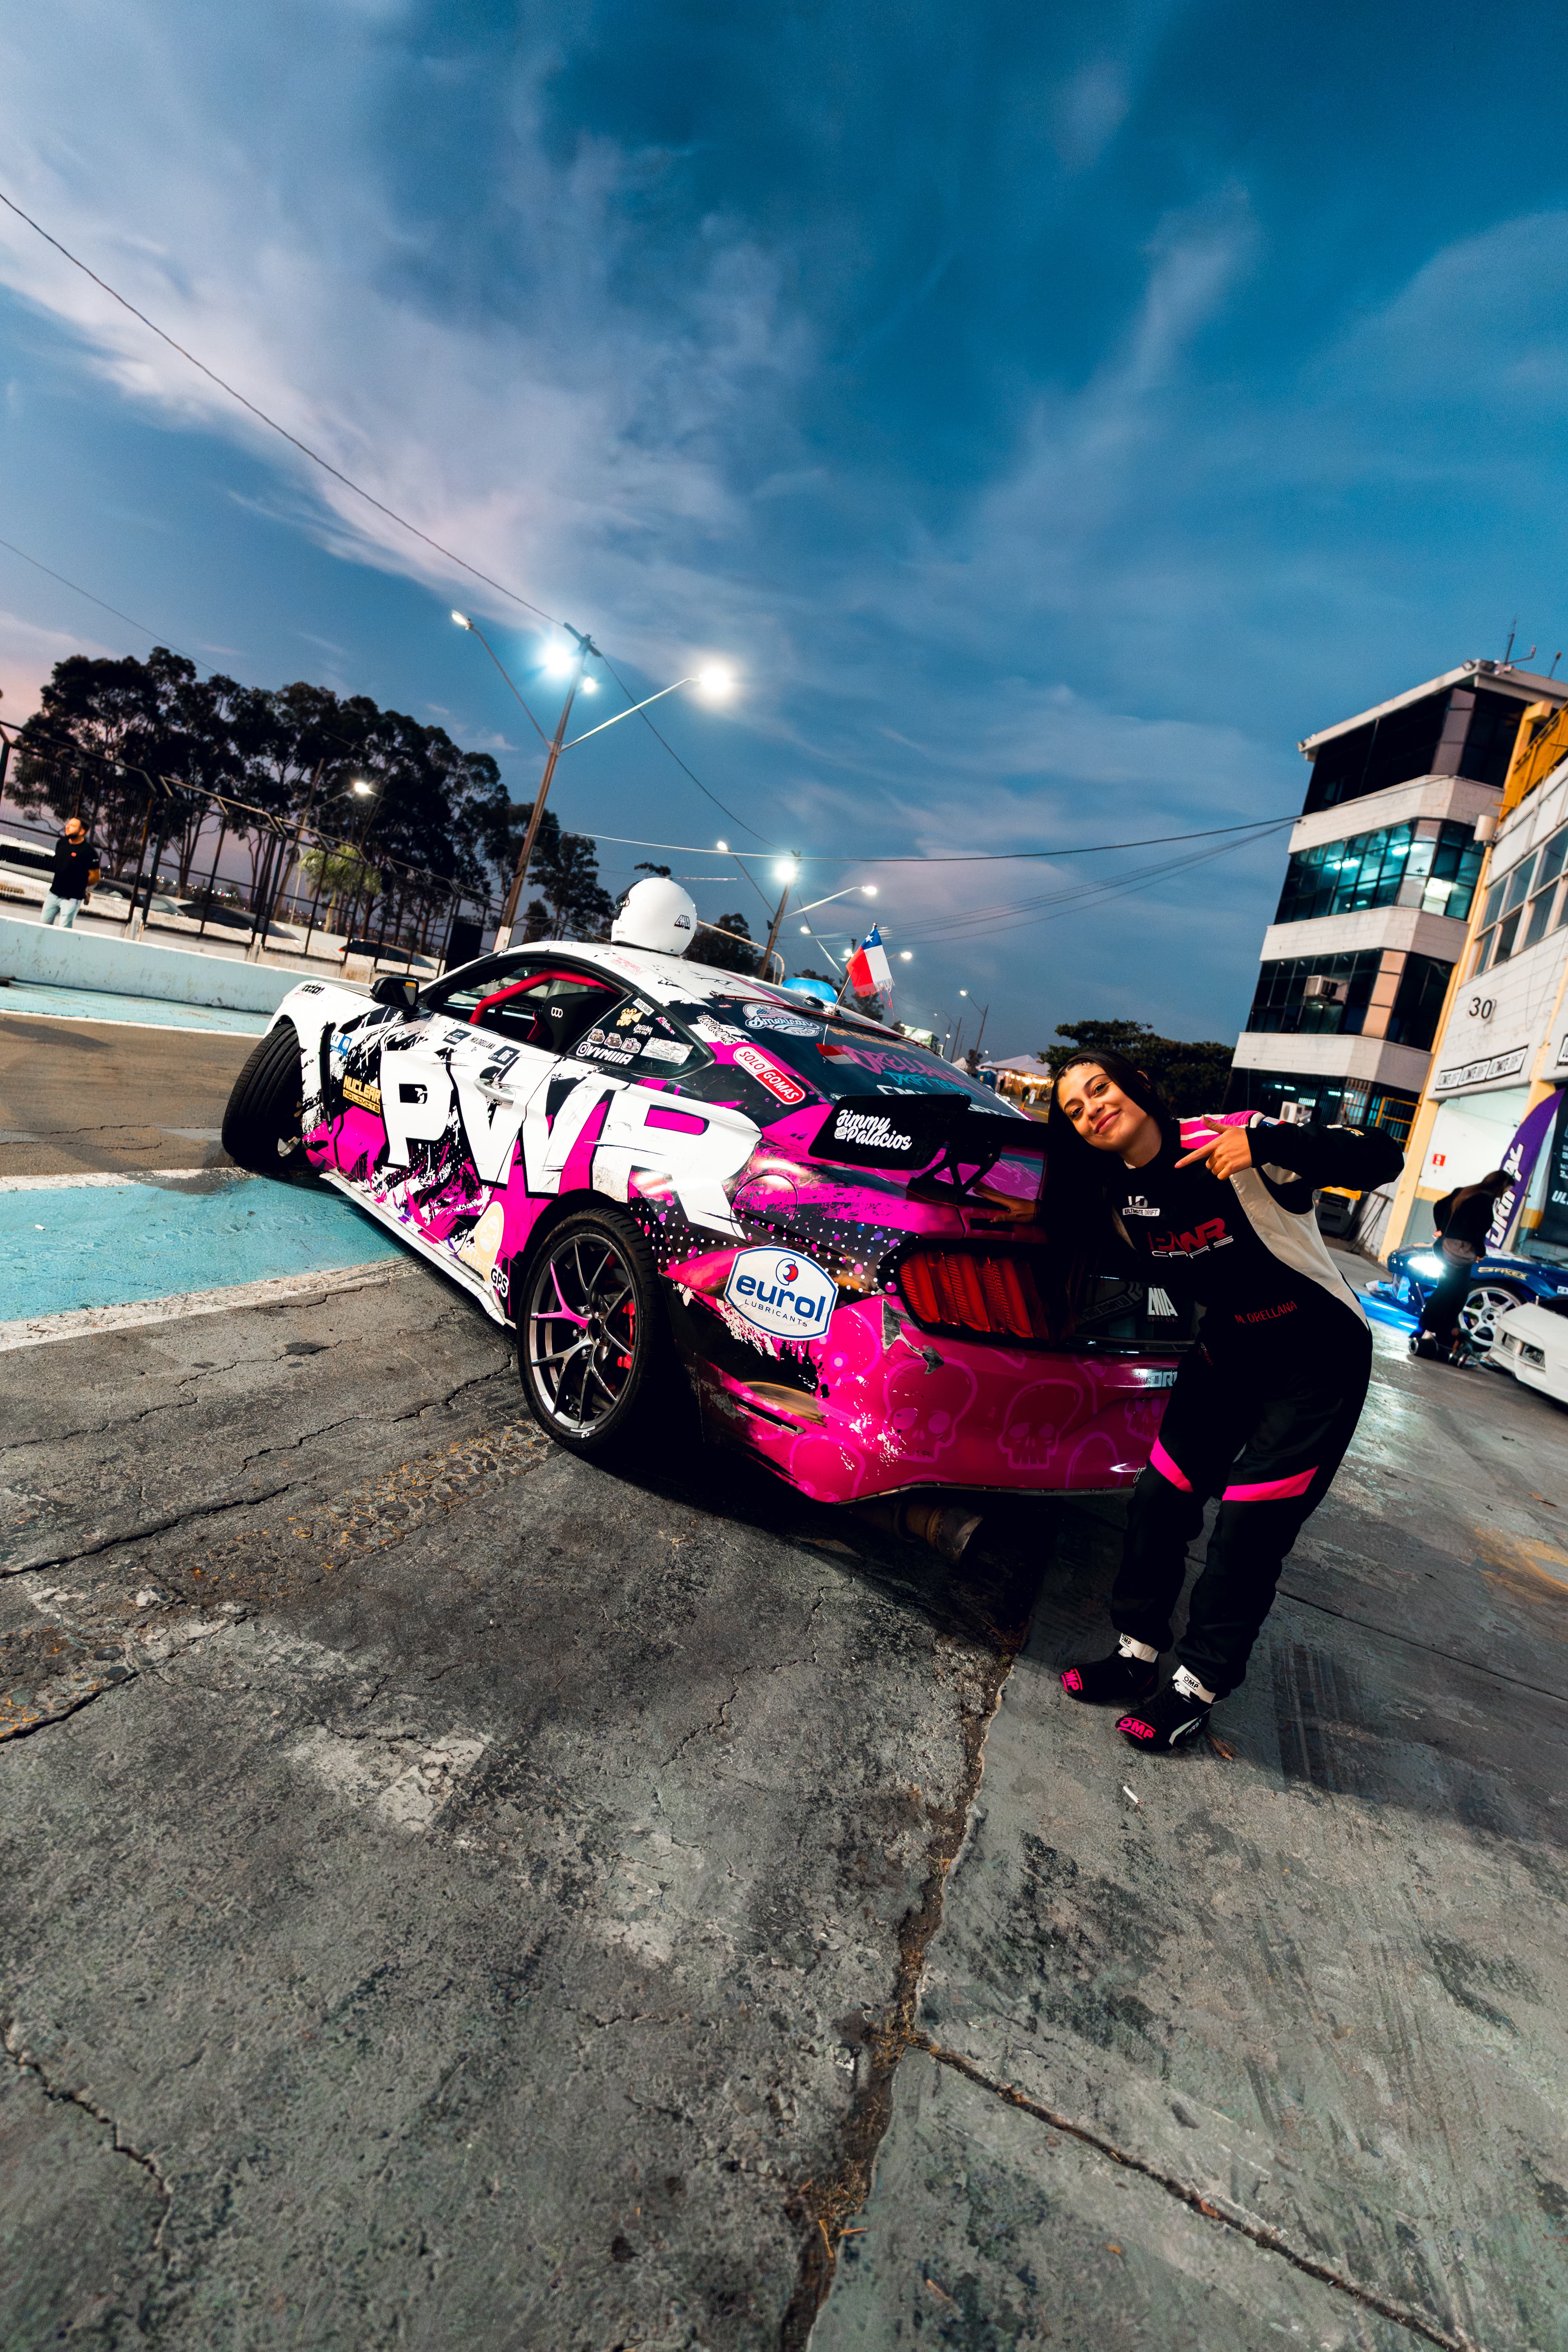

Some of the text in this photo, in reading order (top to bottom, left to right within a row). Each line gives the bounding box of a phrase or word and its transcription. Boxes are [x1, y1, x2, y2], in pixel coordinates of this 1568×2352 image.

[1469, 996, 1492, 1019] 30
[748, 1016, 817, 1029] American
[497, 1050, 513, 1062] 06
[739, 1051, 765, 1069] SOLO
[343, 1075, 381, 1104] NUCLEAR
[763, 1071, 799, 1099] GOMAS
[353, 1095, 379, 1111] LIMITS
[837, 1109, 891, 1136] Jimmy
[846, 1126, 912, 1150] Palacios
[491, 1268, 507, 1294] GPS
[736, 1275, 826, 1322] eurol
[745, 1299, 807, 1327] LUBRICANTS
[1247, 1301, 1297, 1323] ORELLANA
[1121, 1635, 1131, 1645] OMP
[1184, 1676, 1198, 1688] OMP
[1120, 1719, 1154, 1738] OMP
[1186, 1718, 1202, 1735] FIRST
